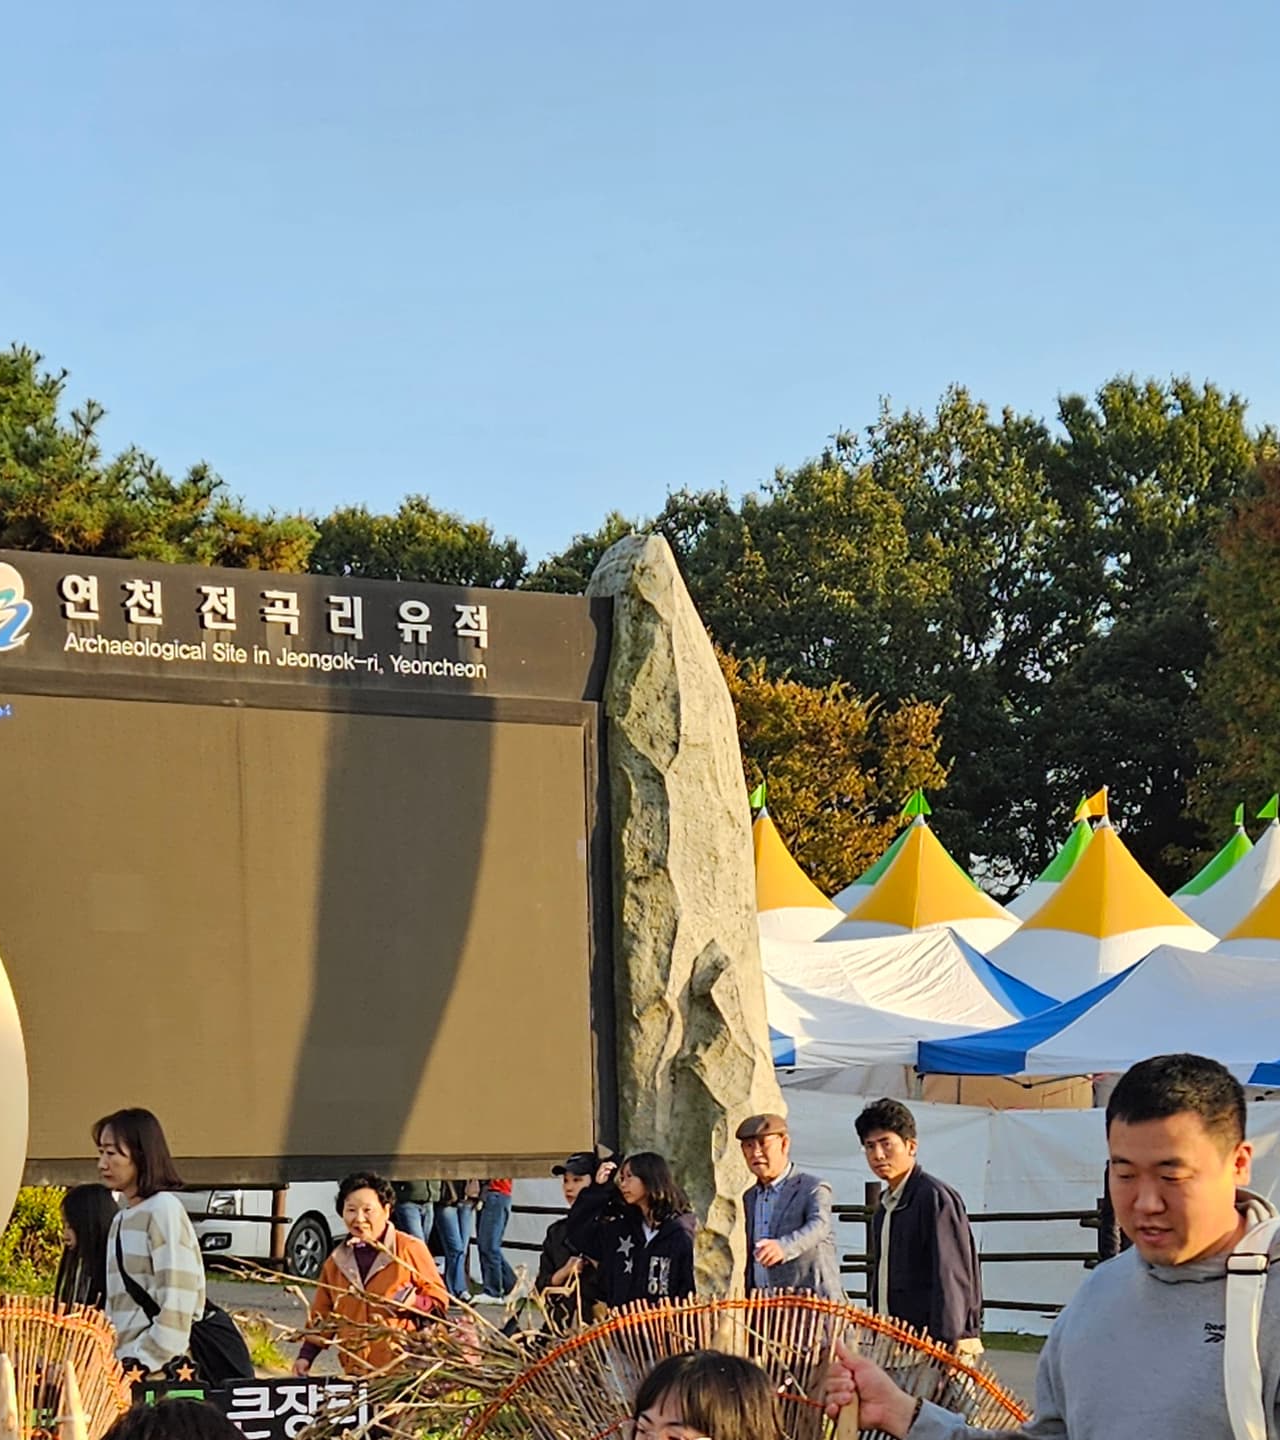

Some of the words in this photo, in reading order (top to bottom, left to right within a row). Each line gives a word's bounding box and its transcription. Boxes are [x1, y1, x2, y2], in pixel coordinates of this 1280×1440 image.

[61, 573, 164, 625] 연천
[198, 584, 365, 641] 전곡리
[396, 599, 489, 649] 유적
[63, 632, 207, 662] Archaeological
[216, 642, 248, 664] Site
[253, 645, 270, 665] in
[388, 654, 488, 680] Yeoncheon
